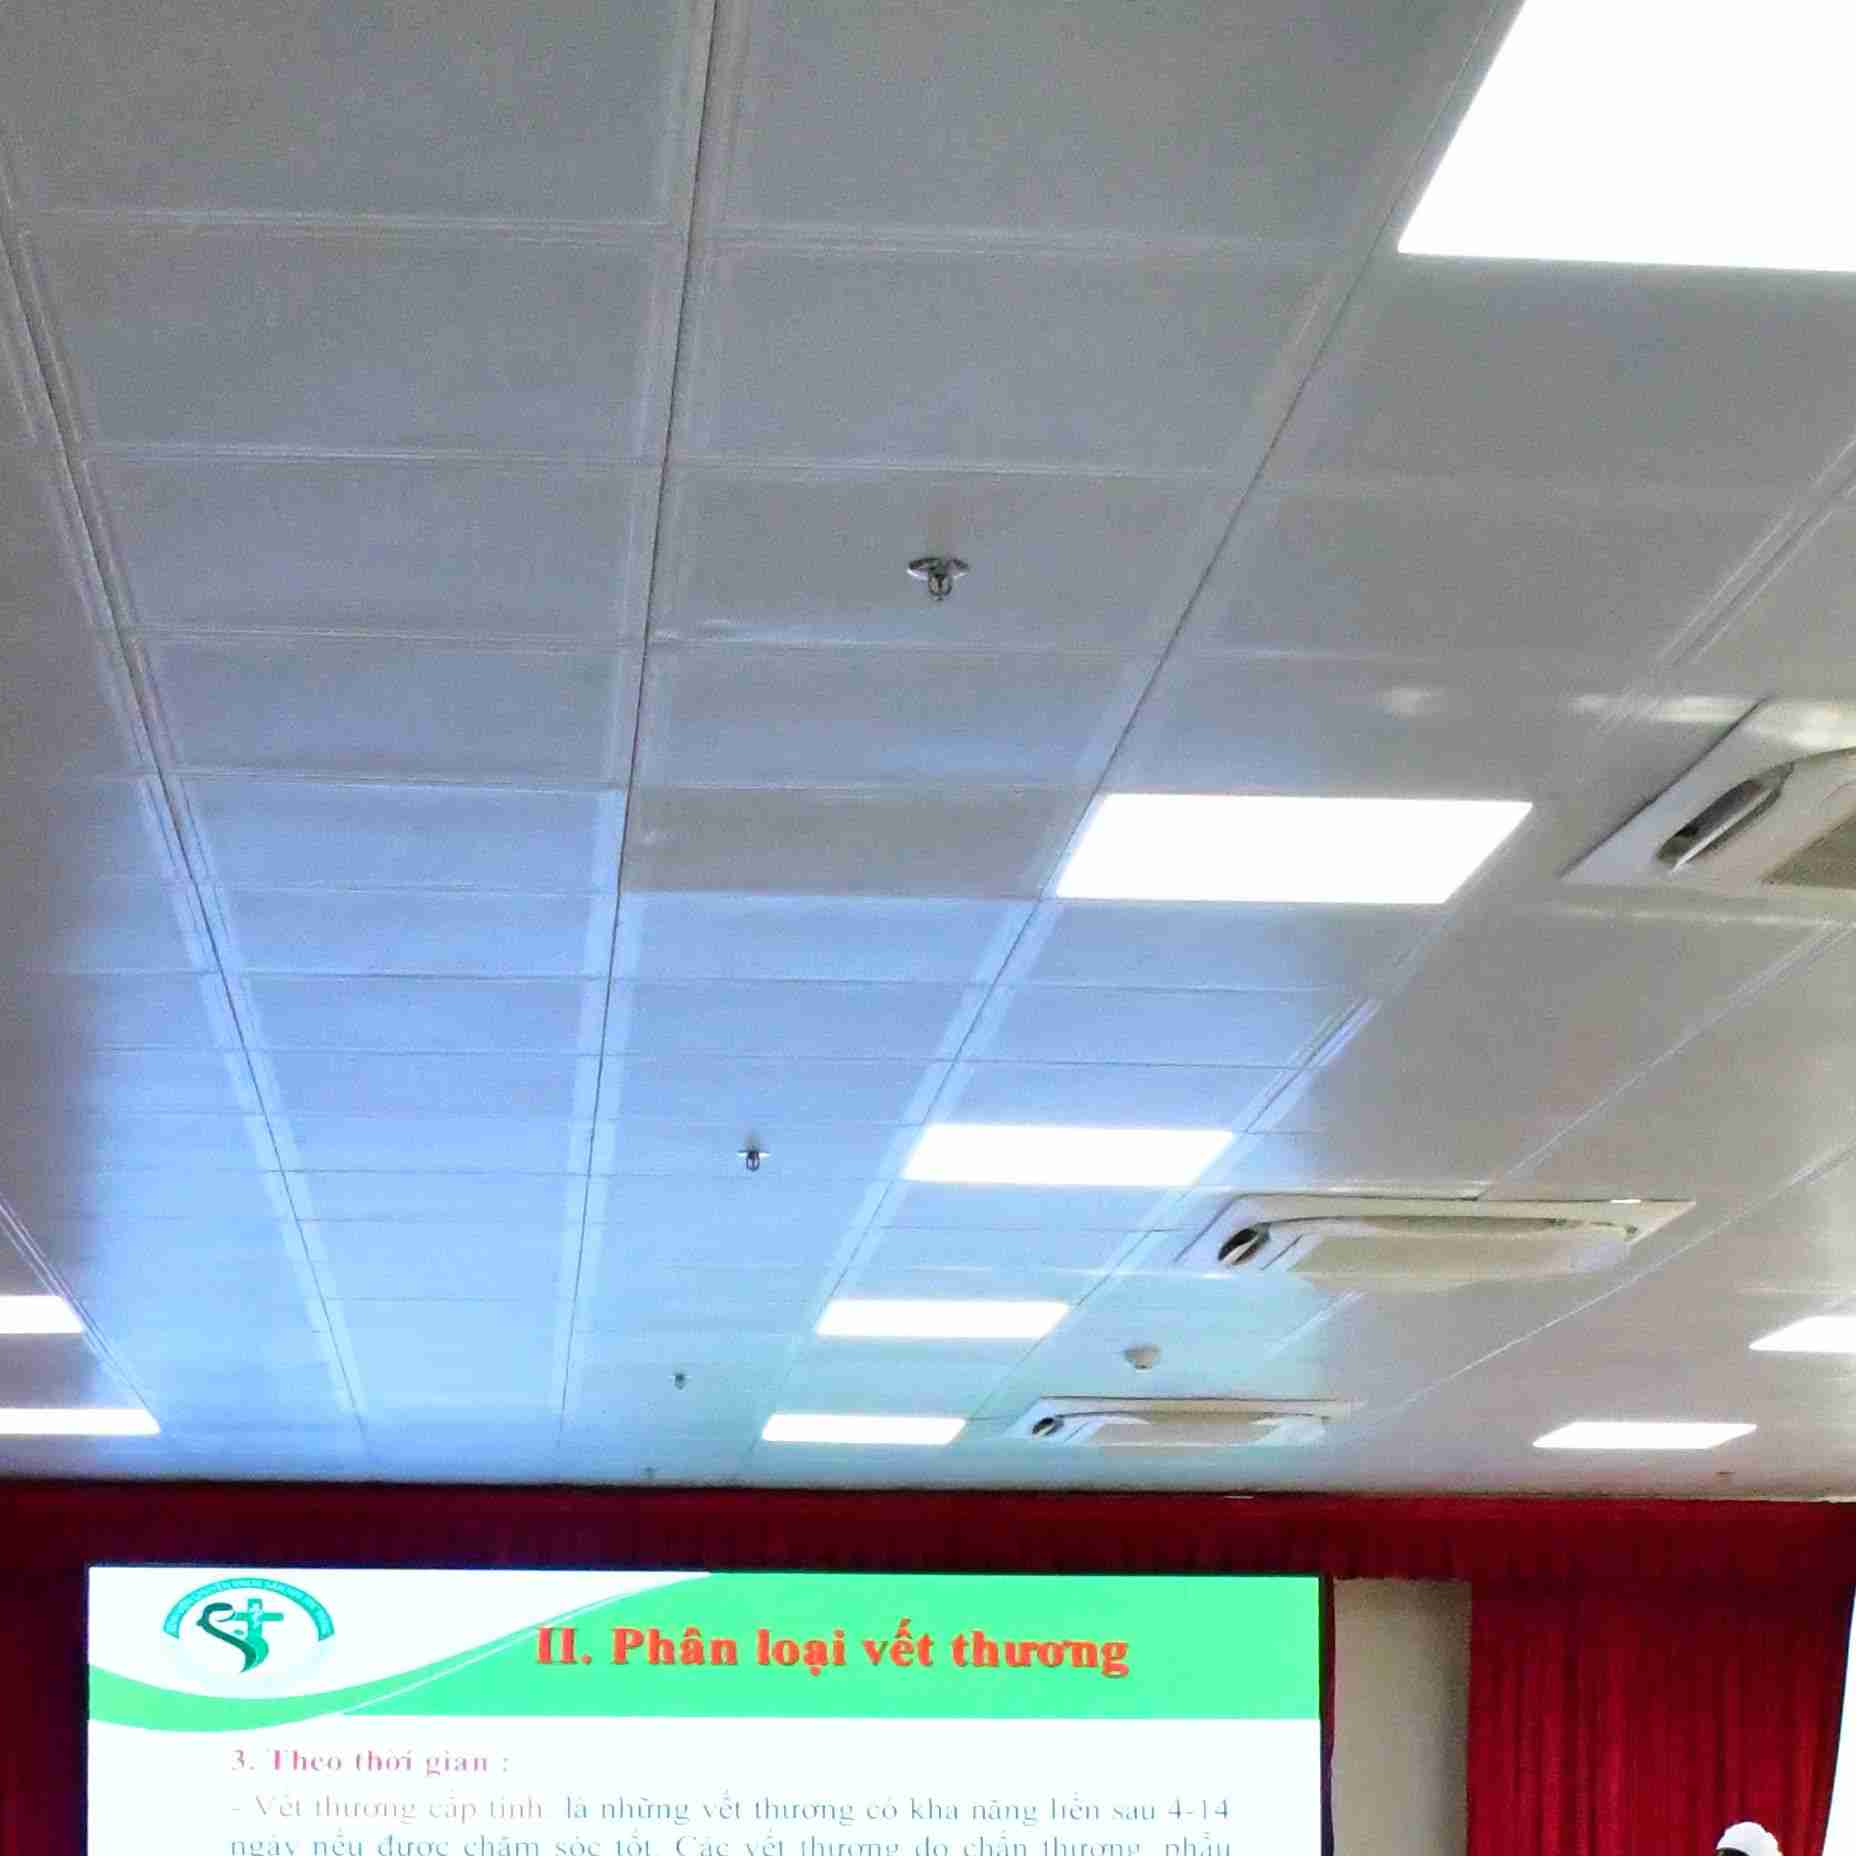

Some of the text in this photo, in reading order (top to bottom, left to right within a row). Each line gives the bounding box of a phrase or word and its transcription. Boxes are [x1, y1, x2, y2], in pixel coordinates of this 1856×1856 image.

[535, 1618, 1129, 1679] II. Phân loại vết thương
[228, 1749, 255, 1771] 3.
[426, 1750, 487, 1777] gian
[1167, 1799, 1229, 1821] 4-14
